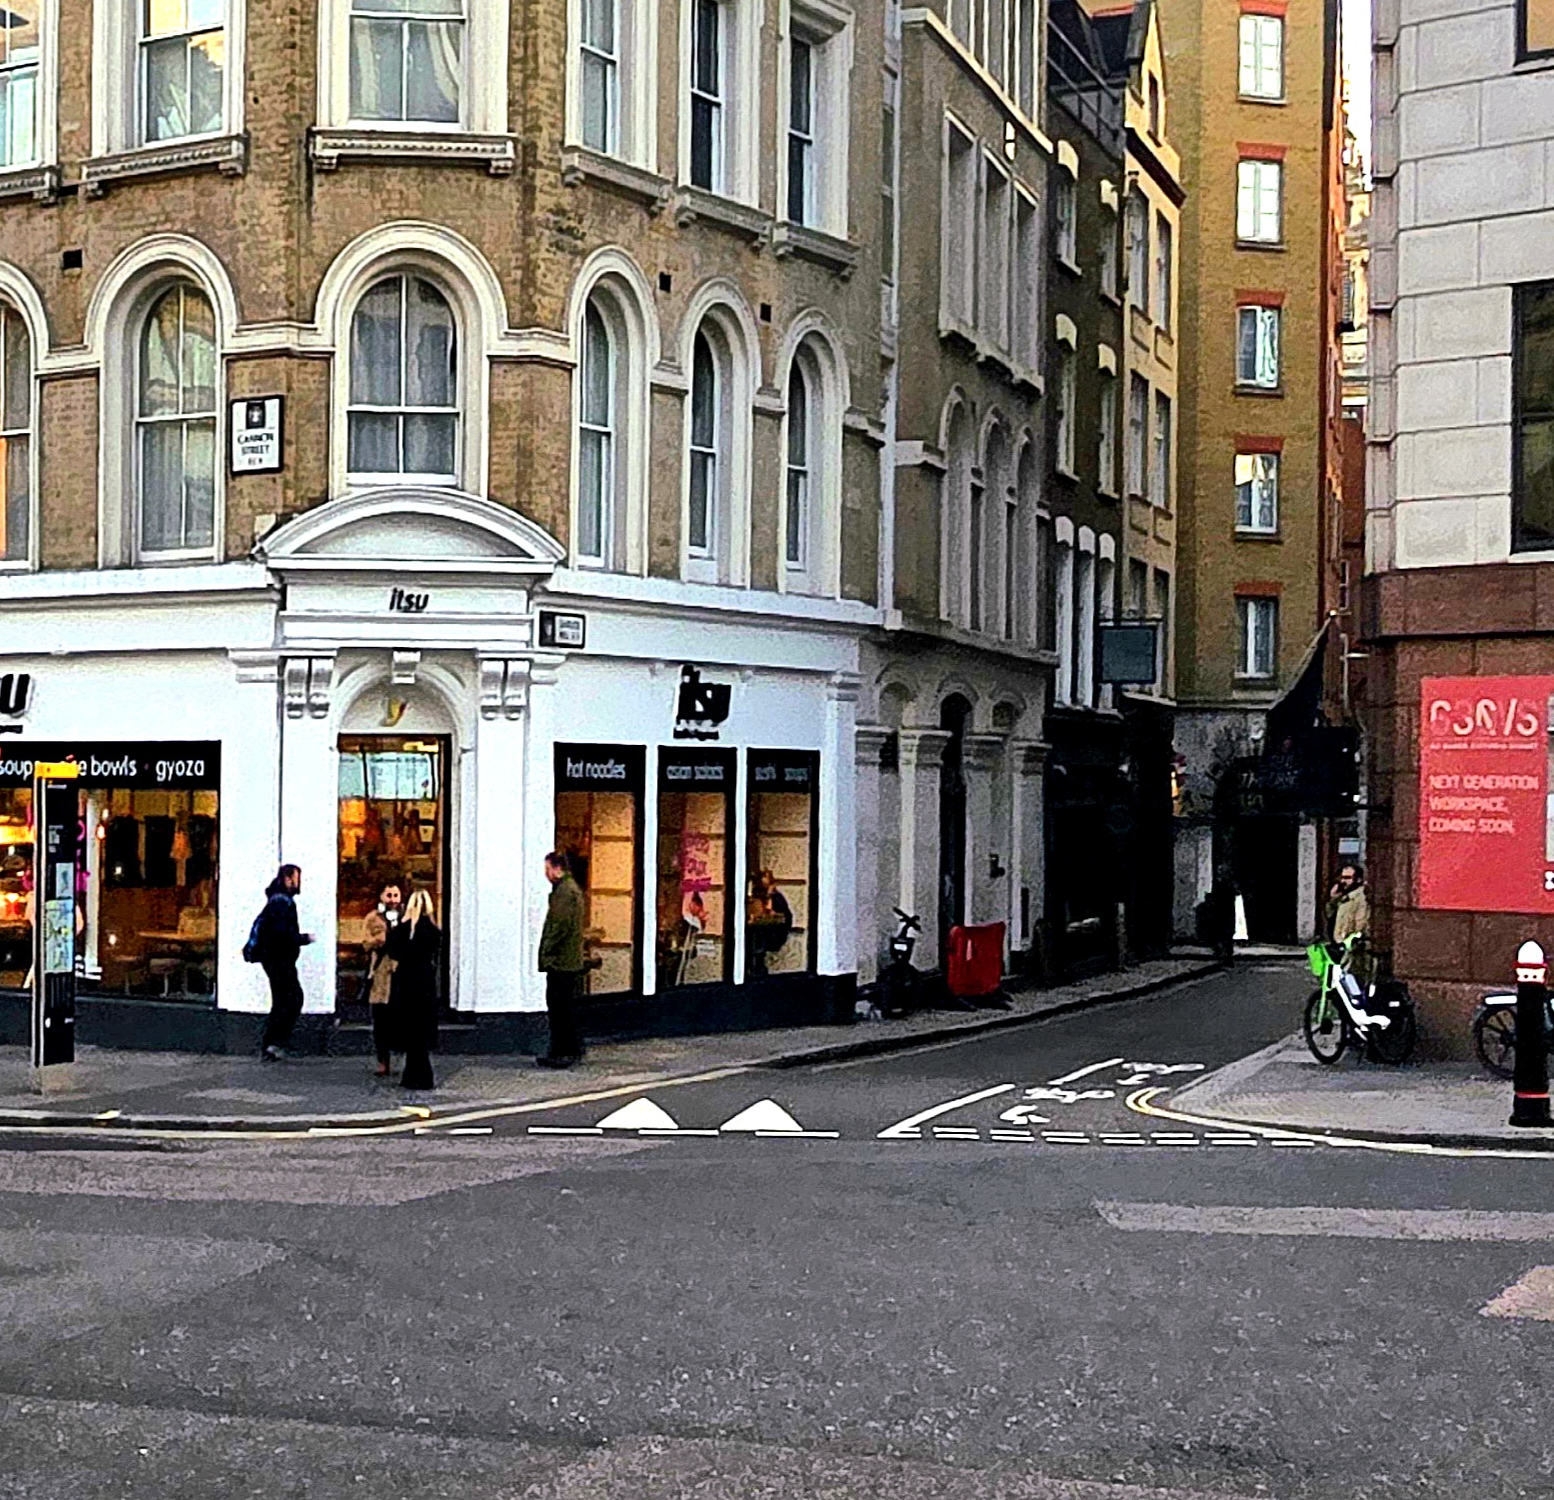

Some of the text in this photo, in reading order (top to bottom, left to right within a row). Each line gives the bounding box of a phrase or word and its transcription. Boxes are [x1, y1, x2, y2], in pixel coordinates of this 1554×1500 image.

[388, 586, 430, 612] itsu
[90, 754, 137, 777] bowls
[155, 758, 205, 782] gyoza
[585, 758, 626, 780] noodles
[1462, 774, 1540, 791] GENERATION
[1428, 816, 1477, 833] COMING
